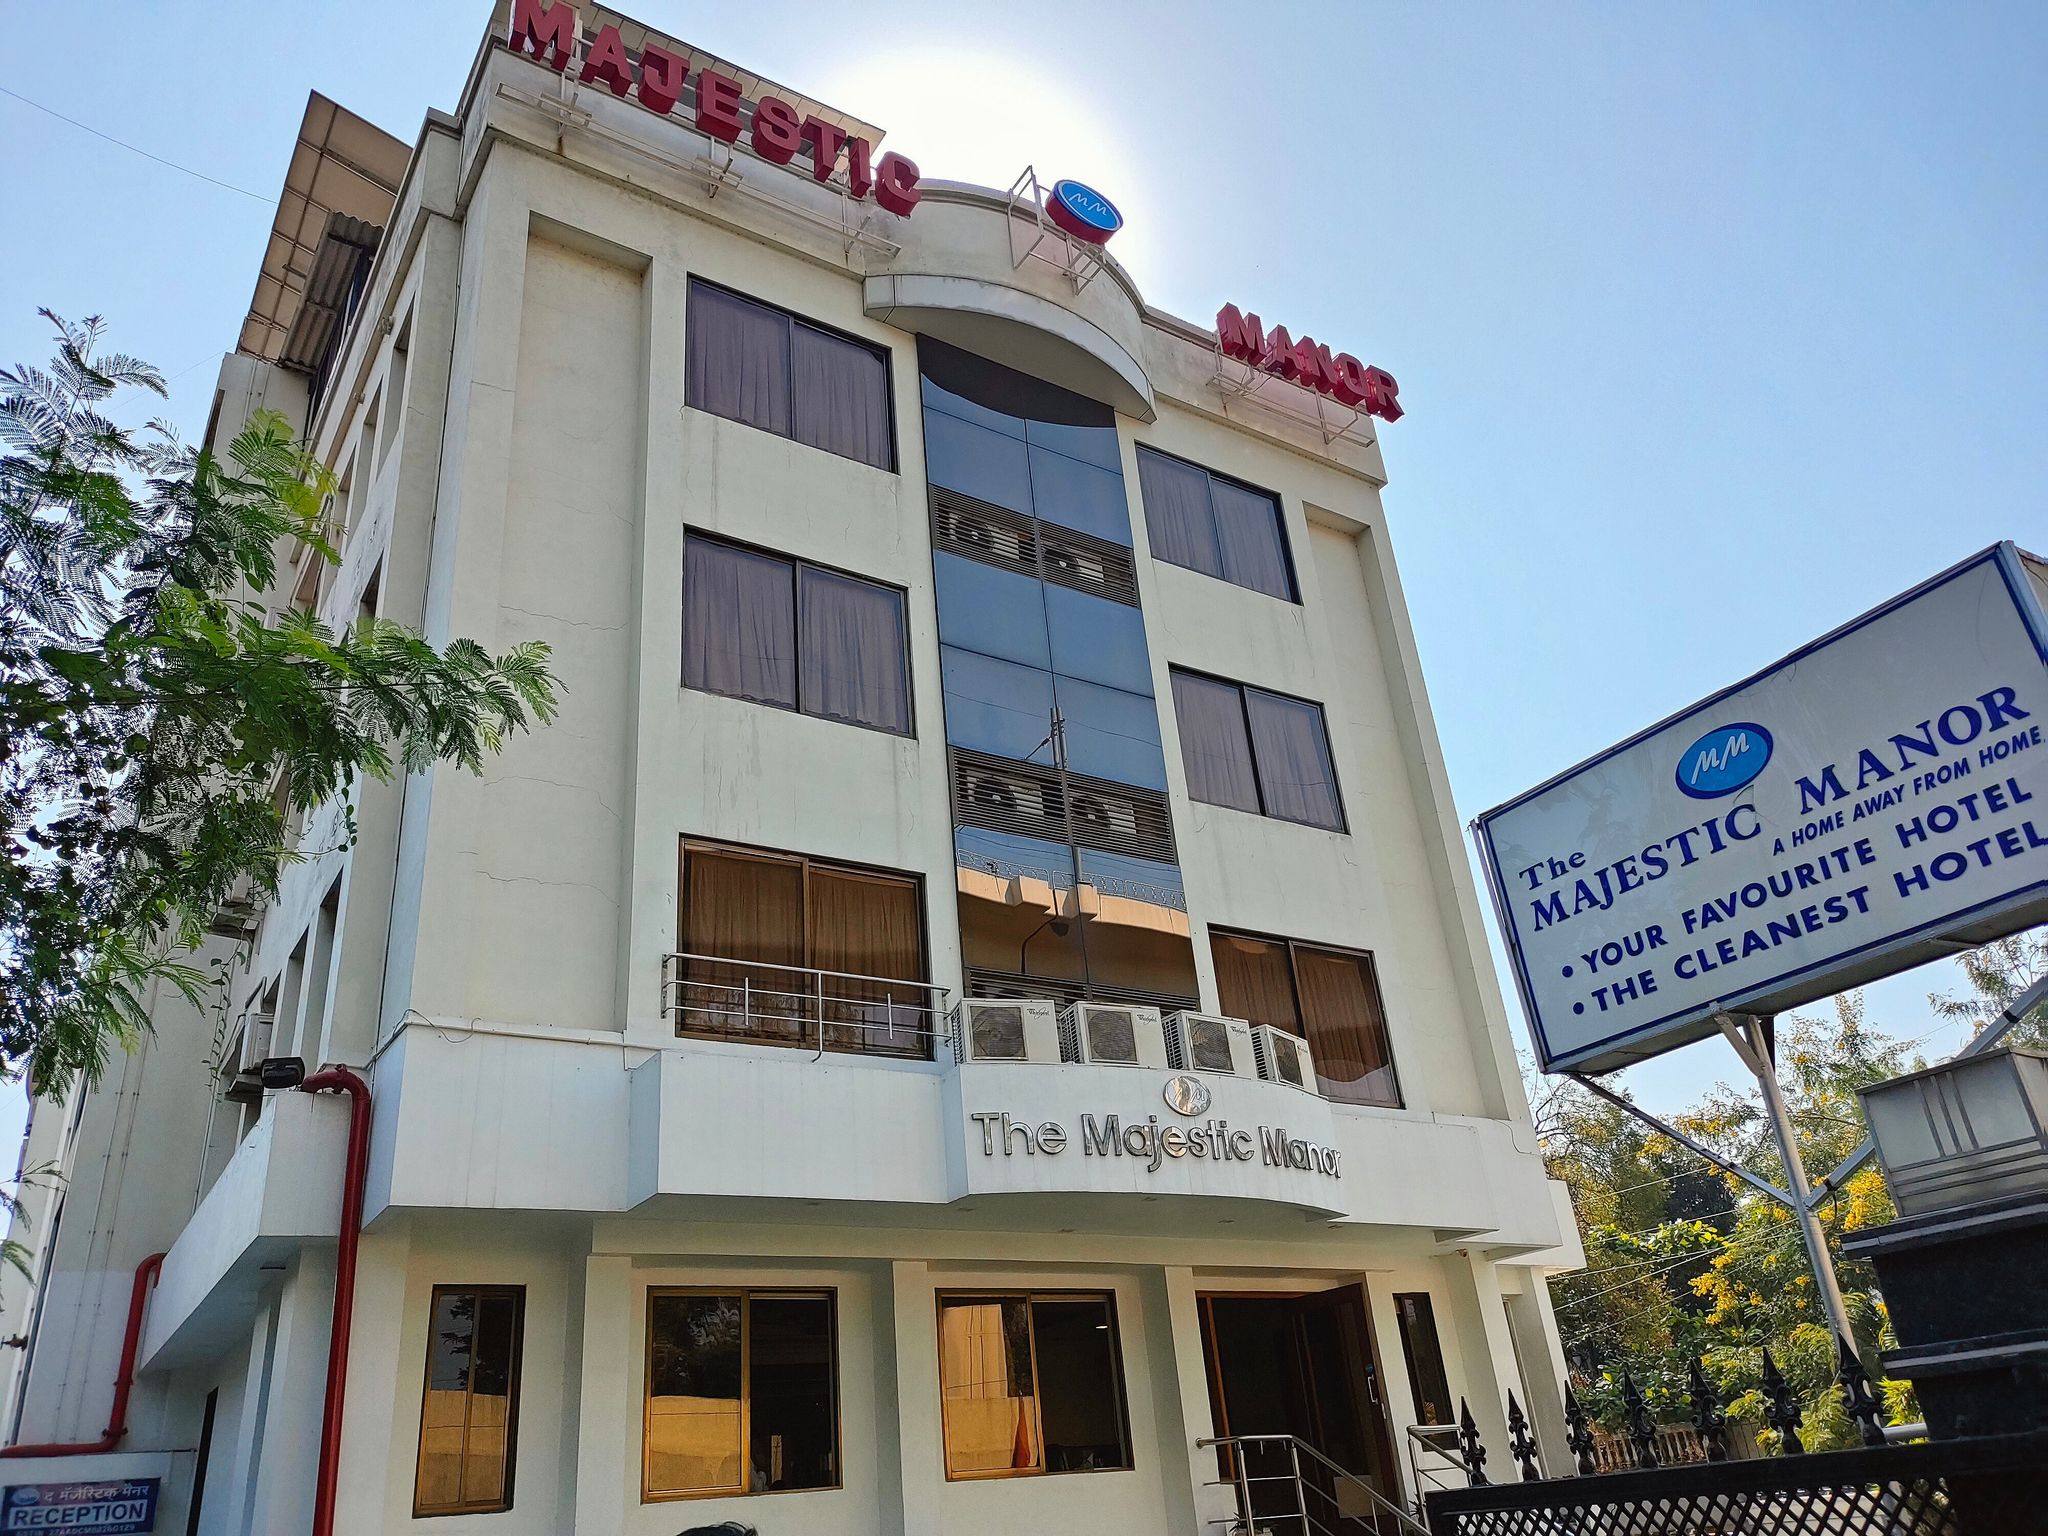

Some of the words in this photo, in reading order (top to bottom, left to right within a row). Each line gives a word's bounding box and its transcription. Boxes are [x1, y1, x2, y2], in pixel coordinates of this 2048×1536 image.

[508, 0, 922, 217] MAJESTIC
[1216, 302, 1404, 424] MANOR
[1530, 804, 1761, 931] MAJESTIC
[1794, 686, 2030, 815] MANOR
[1691, 732, 1750, 784] MM
[1773, 838, 1785, 856] A
[1791, 810, 1844, 847] HOME
[1852, 784, 1905, 822] AWAY
[1913, 757, 1971, 795] FROM
[1519, 852, 1586, 890] The
[1581, 925, 1668, 974] YOUR
[1682, 838, 1876, 934] FAVOURITE
[1895, 777, 2033, 848] HOTEL
[1591, 969, 1658, 1011] THE
[1674, 884, 1869, 979] CLEANEST
[1893, 821, 2048, 898] HOTEL
[971, 1111, 1067, 1155] The
[1081, 1113, 1255, 1172] Majestic
[1258, 1125, 1342, 1178] Manor
[14, 1502, 144, 1526] RECEPTION
